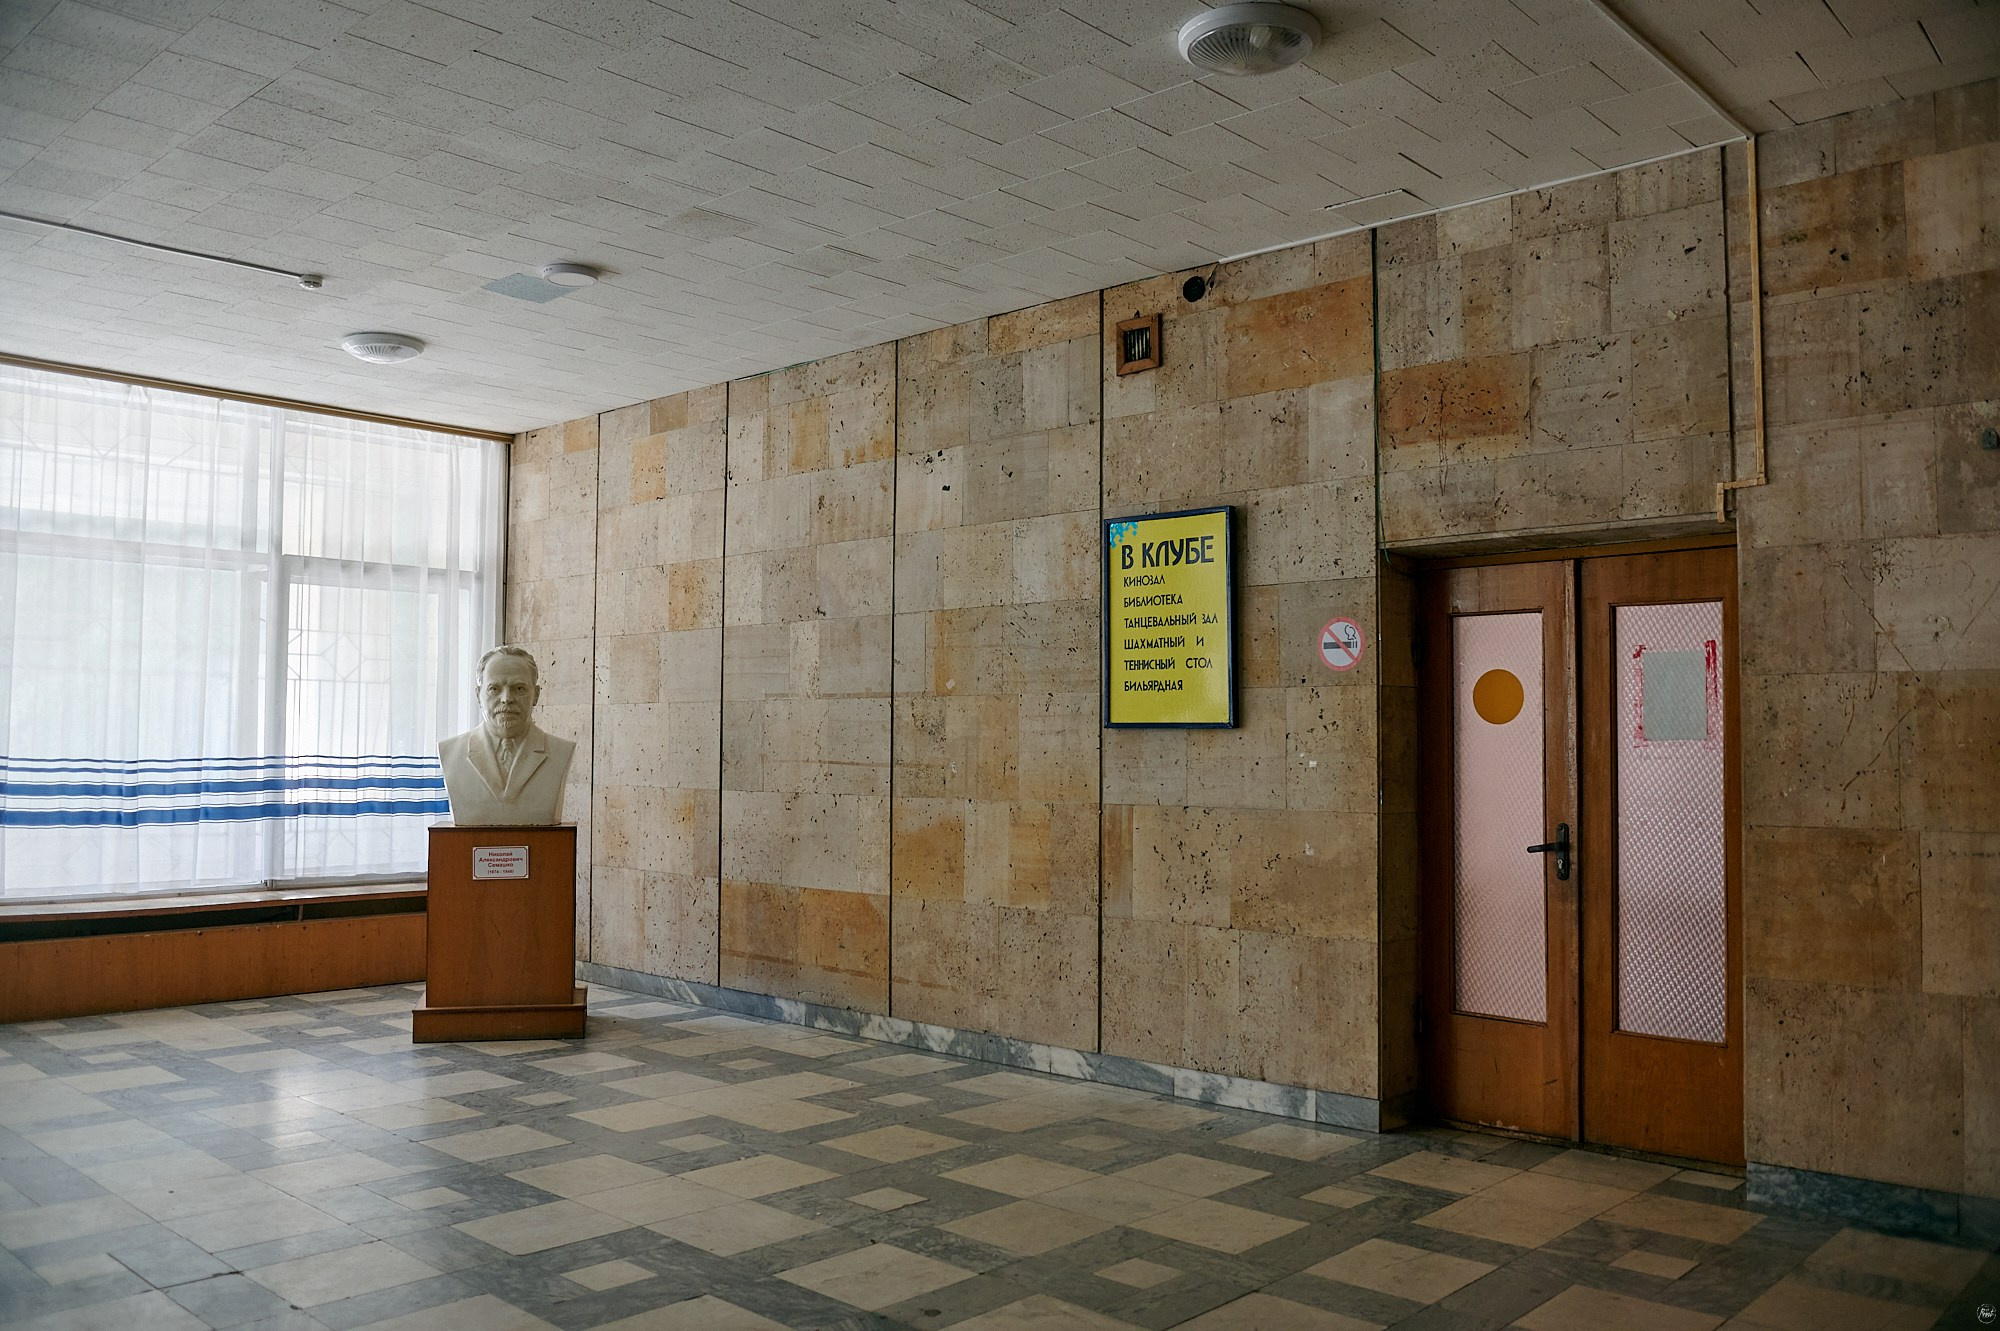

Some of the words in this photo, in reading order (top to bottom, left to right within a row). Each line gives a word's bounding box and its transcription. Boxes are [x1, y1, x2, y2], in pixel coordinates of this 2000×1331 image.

[1121, 544, 1134, 570] В
[1142, 535, 1214, 568] КЛУБЕ
[1123, 574, 1165, 588] КИНОЗАЛ
[1123, 594, 1183, 608] БИБЛИОТЕКА
[1124, 612, 1197, 629] ТАНЦЕВАЛЬНЫЙ
[1202, 613, 1218, 624] ЗАЛ
[1124, 635, 1185, 650] ШАХМАТНЫЙ
[1196, 635, 1204, 647] И
[1124, 657, 1175, 671] ТЕННИСНЫЙ
[1185, 657, 1213, 669] СТОЛ
[1124, 679, 1183, 692] БИЛЬЯРДНАЯ
